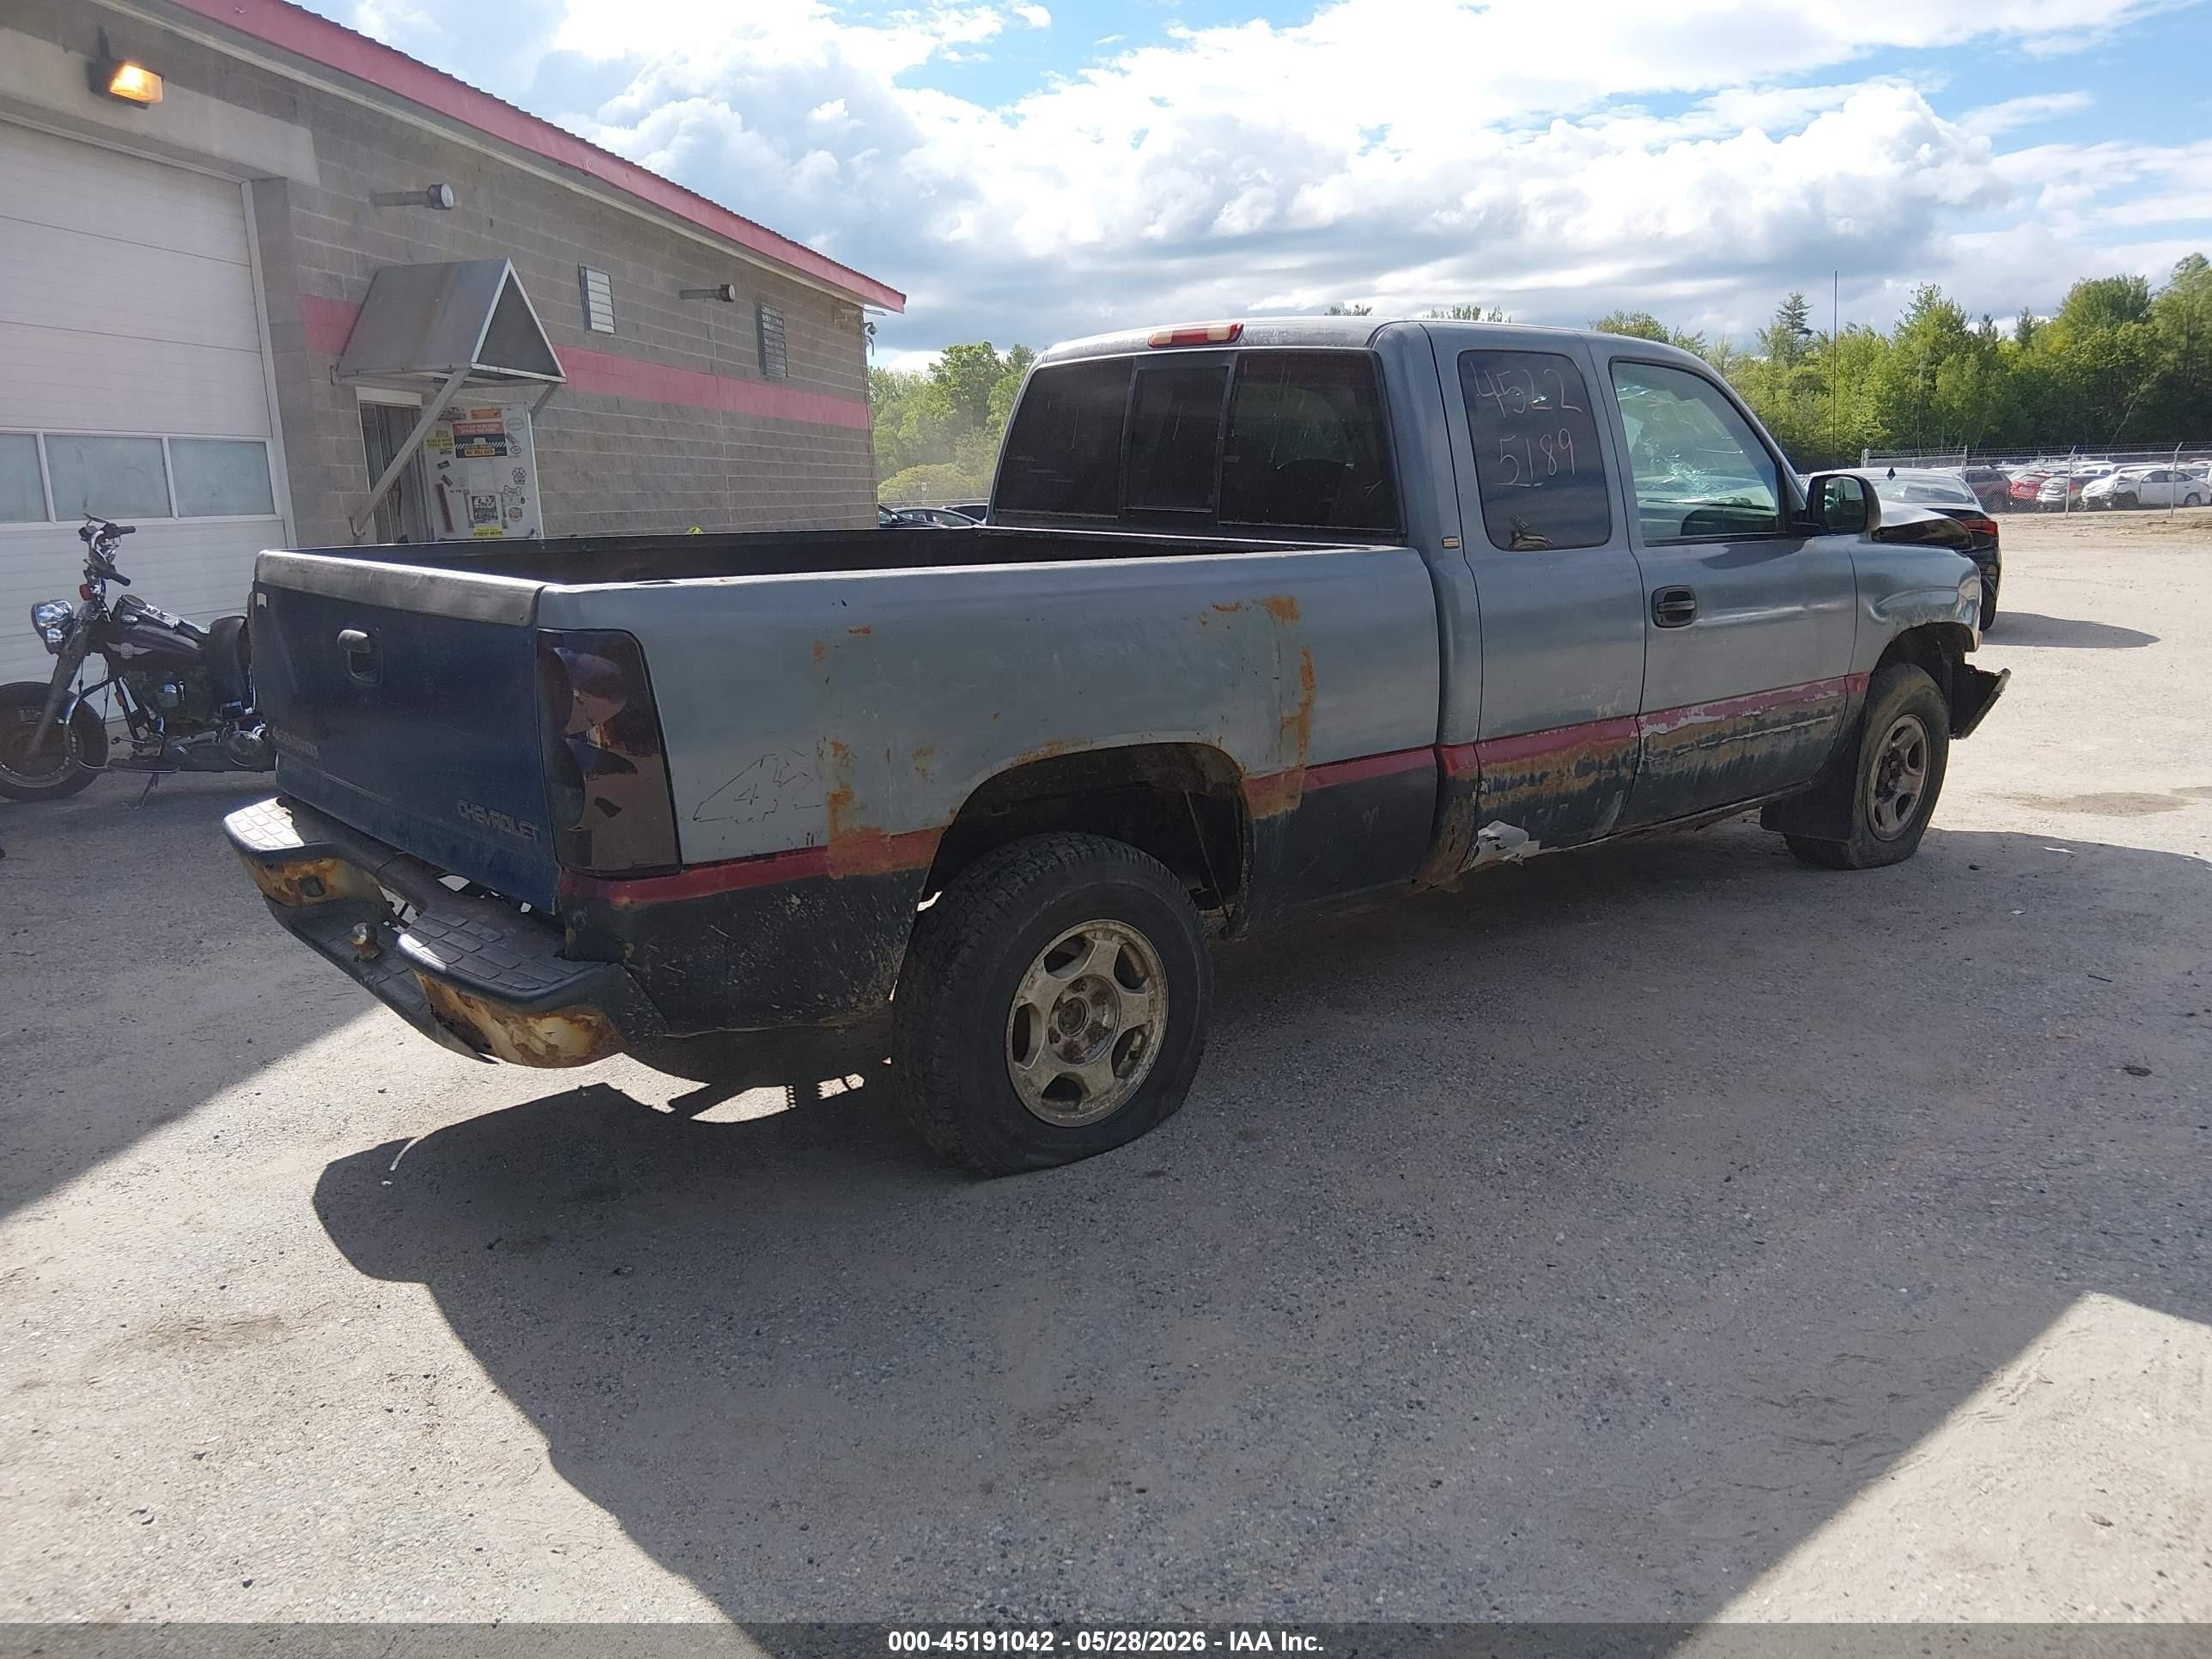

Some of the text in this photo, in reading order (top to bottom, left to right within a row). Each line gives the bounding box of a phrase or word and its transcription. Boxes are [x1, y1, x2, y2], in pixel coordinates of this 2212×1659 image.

[1469, 361, 1583, 418] 4522
[1498, 428, 1576, 485] 5189
[457, 799, 538, 842] CHEVROLET
